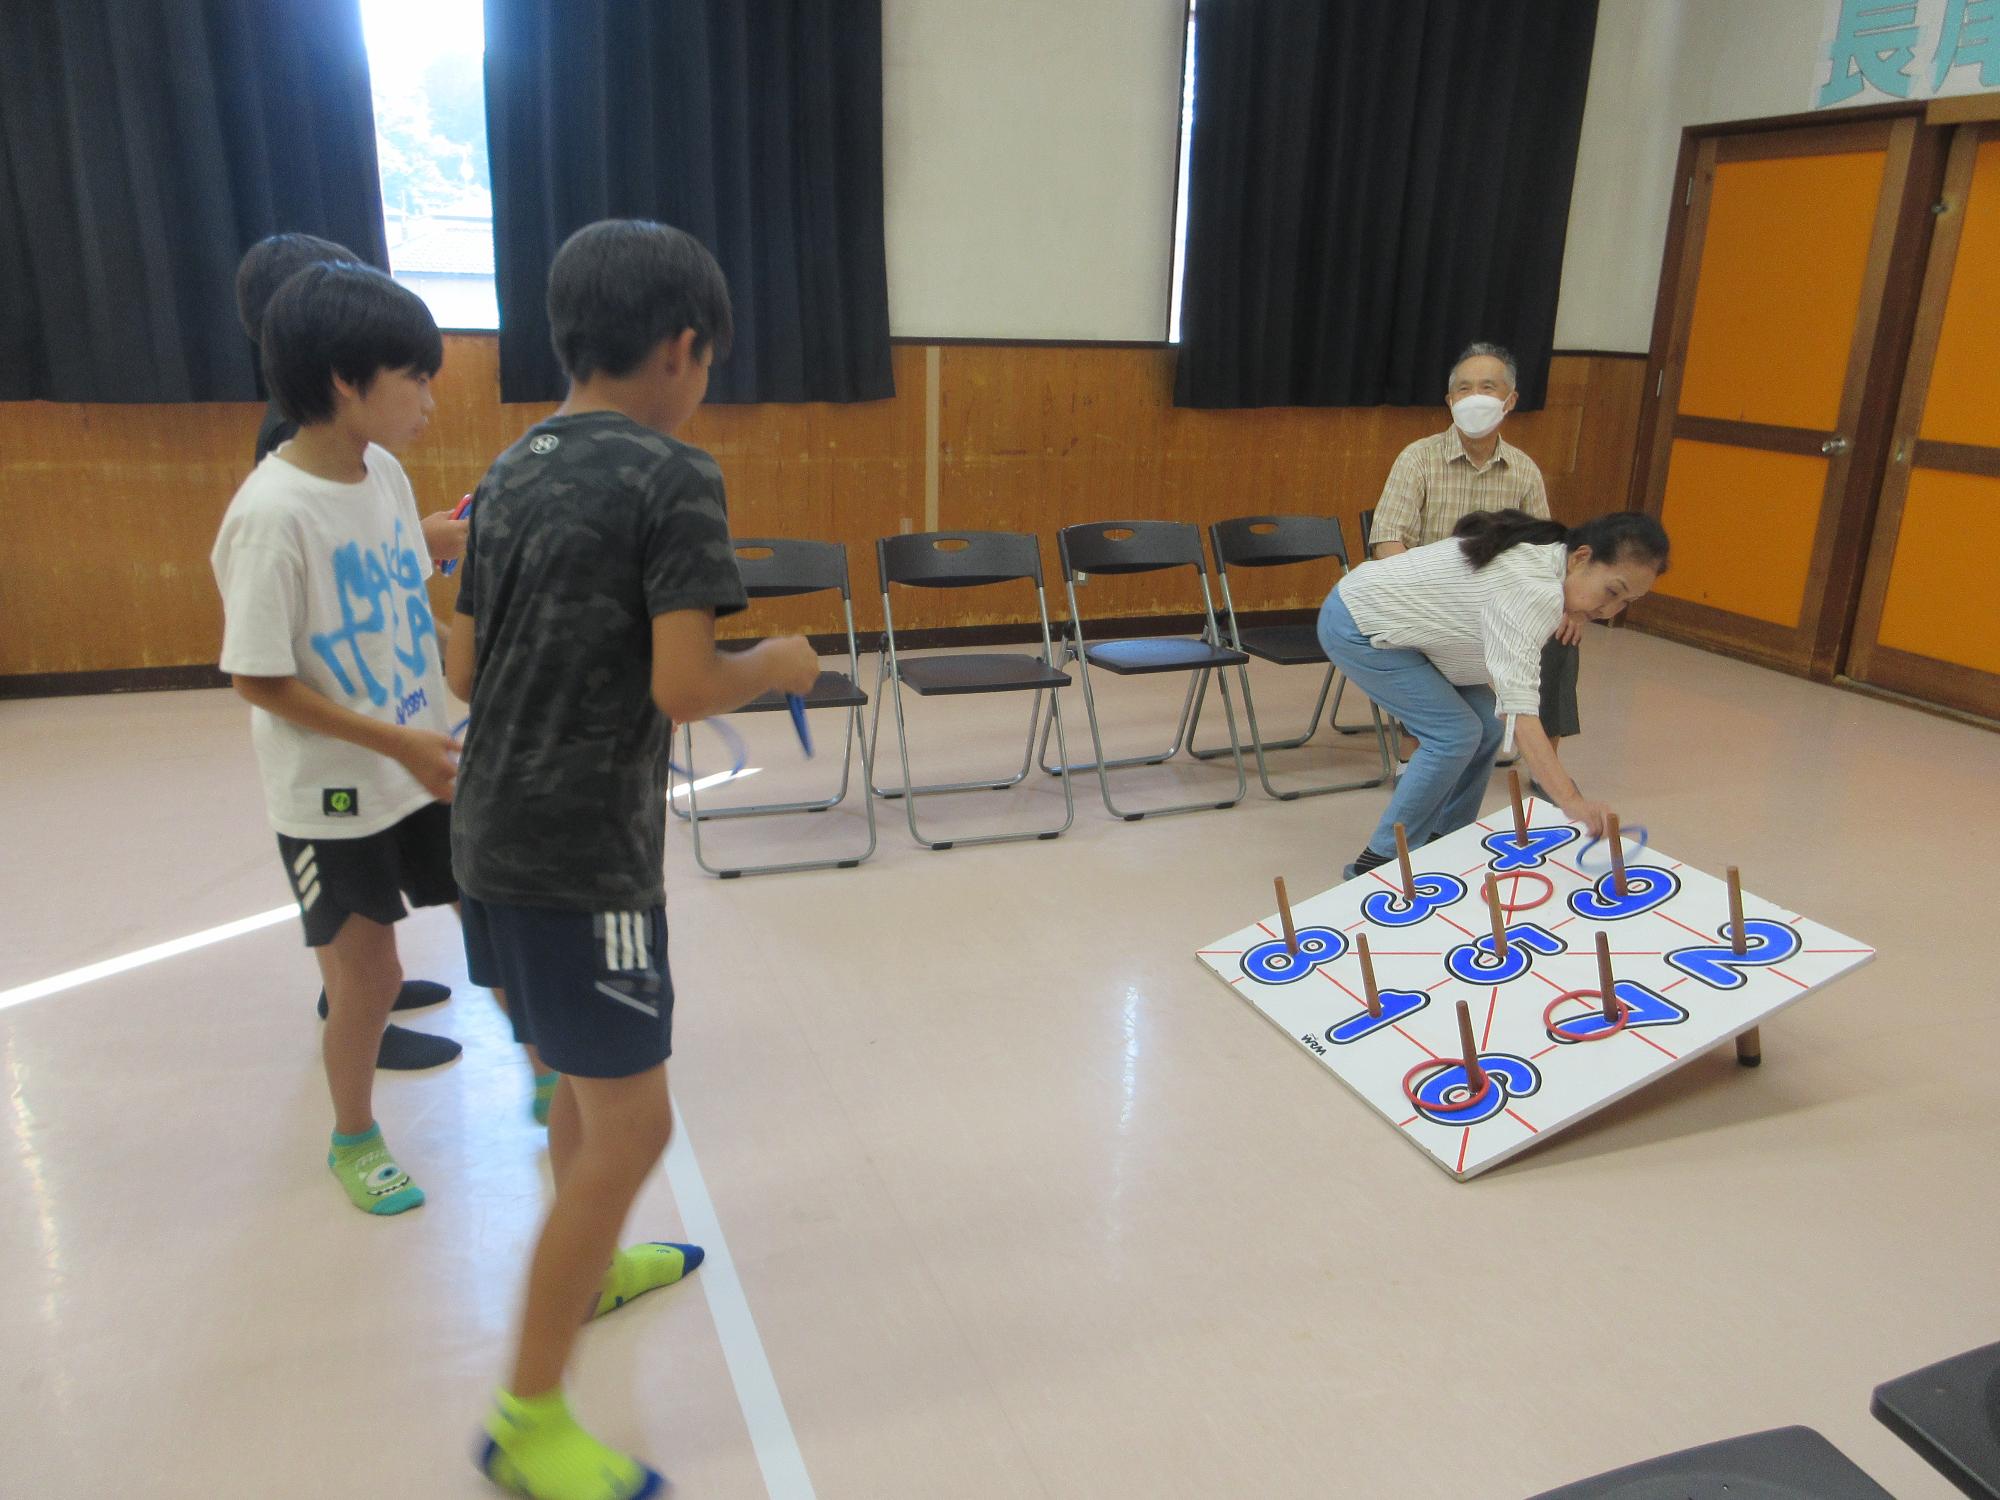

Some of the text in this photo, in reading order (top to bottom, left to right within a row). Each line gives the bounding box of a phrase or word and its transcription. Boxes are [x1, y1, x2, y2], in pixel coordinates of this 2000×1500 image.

[1481, 825, 1580, 872] 4
[1361, 872, 1467, 927] 3
[1567, 864, 1681, 920] 9
[1240, 925, 1349, 984] 8
[1444, 923, 1568, 984] 5
[1664, 918, 1803, 991] 2
[1325, 989, 1431, 1045] 1
[1546, 979, 1689, 1045] 7
[1412, 1052, 1542, 1126] 6
